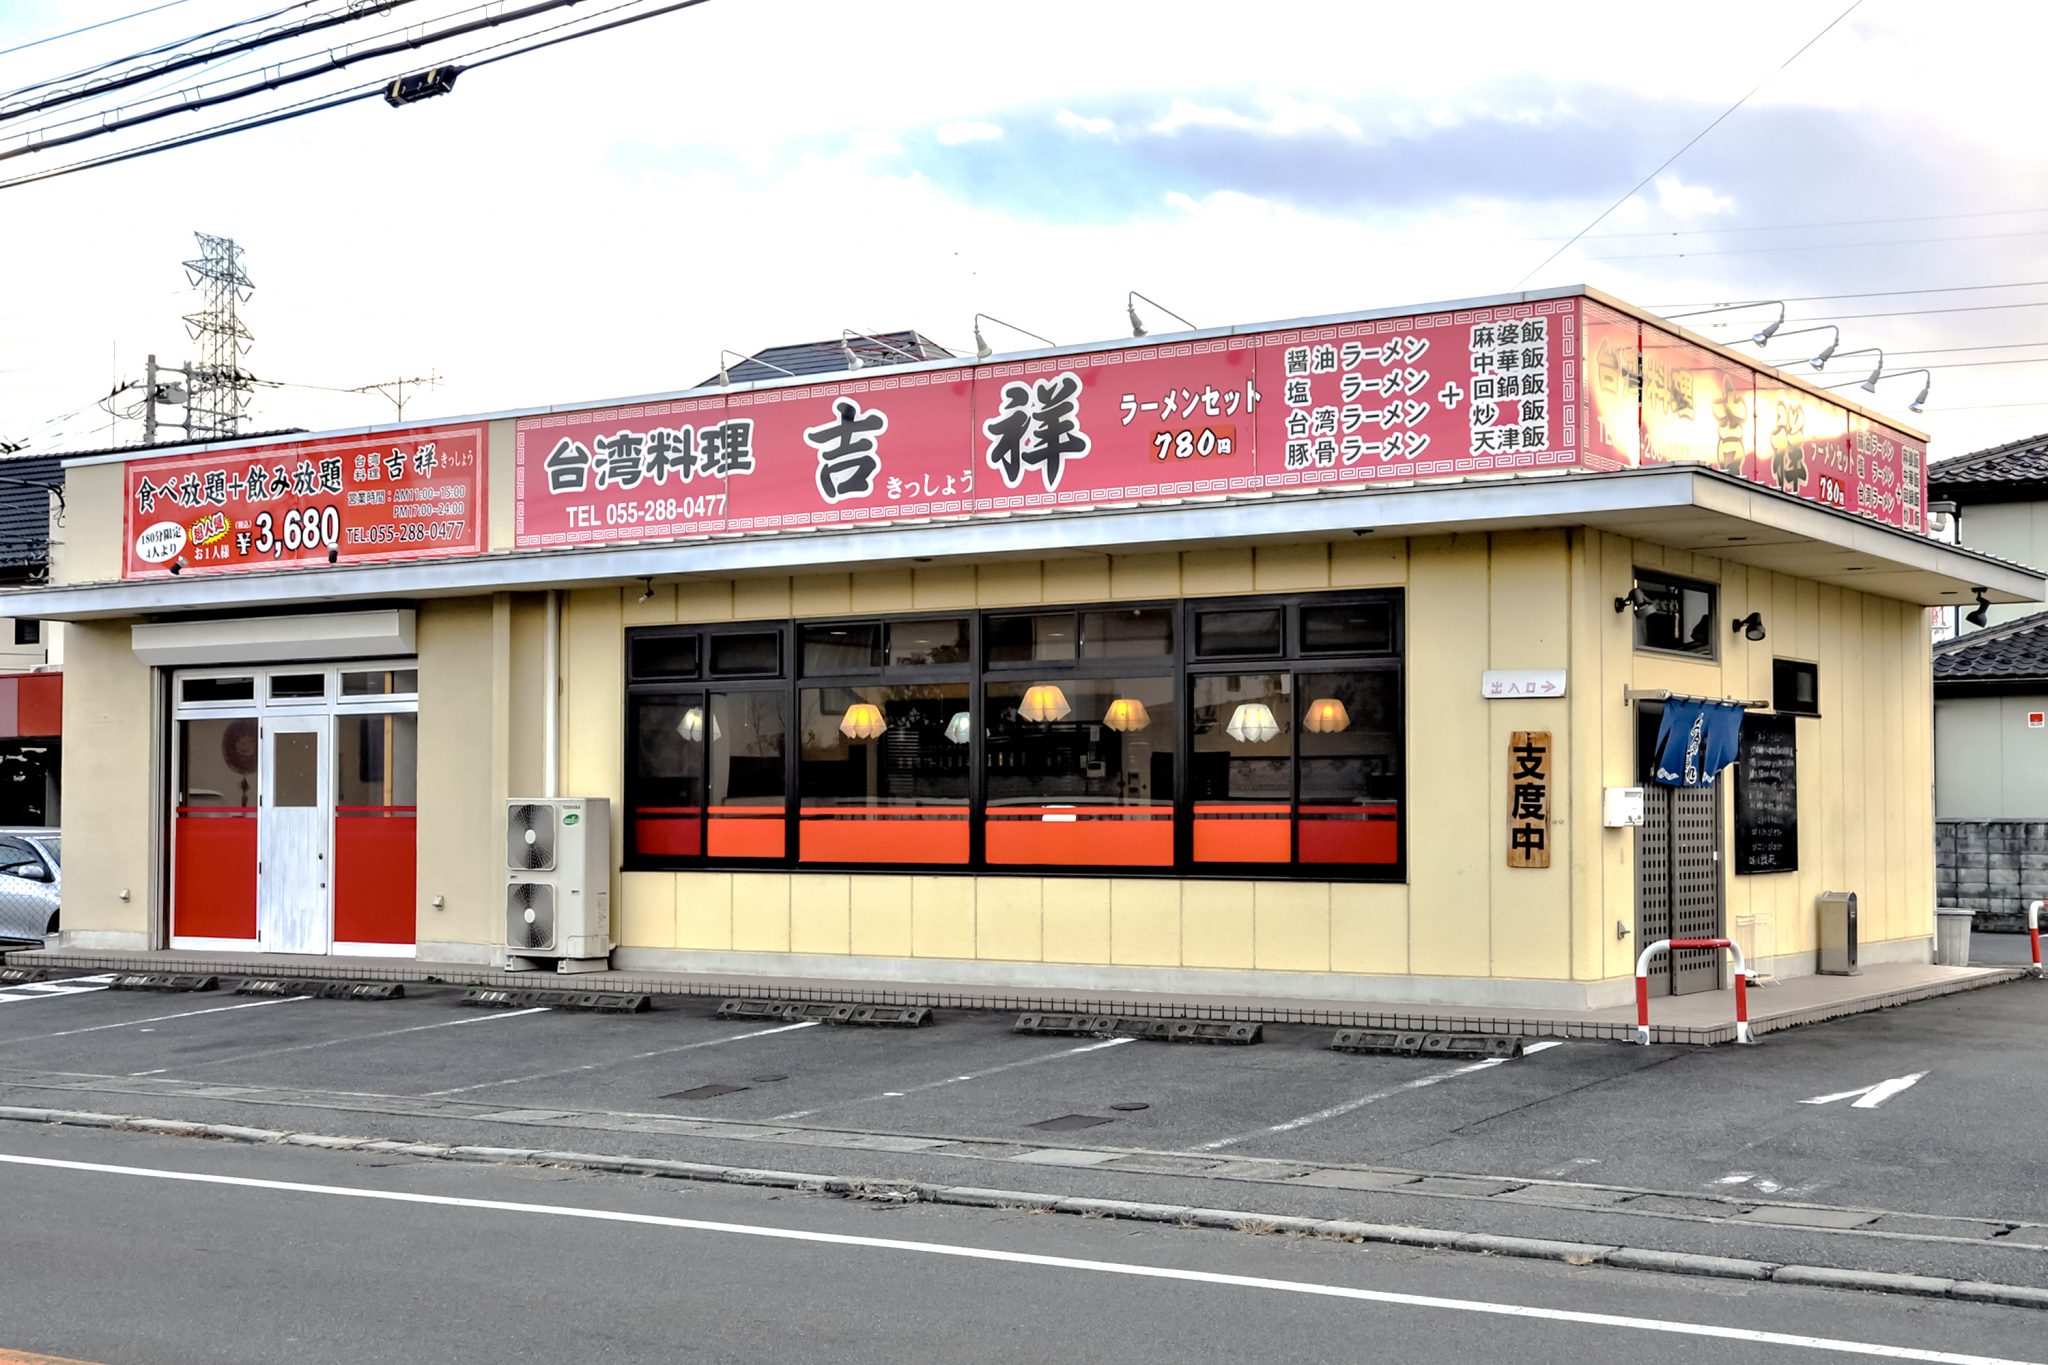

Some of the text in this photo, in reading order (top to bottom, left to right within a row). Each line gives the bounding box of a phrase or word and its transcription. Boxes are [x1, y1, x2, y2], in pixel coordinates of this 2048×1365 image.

[1471, 317, 1547, 350] 麻婆飯
[1286, 336, 1429, 376] 醤油ラーメン
[1471, 345, 1547, 375] 中華飯
[1120, 379, 1262, 426] ラーメンセット
[1471, 371, 1547, 402] 回鍋飯
[1286, 399, 1429, 438] 台湾ラーメン
[544, 418, 755, 494] 台湾料理
[1153, 428, 1232, 461] 780円
[1286, 431, 1429, 468] 豚骨ラーメン
[1471, 424, 1547, 455] 天津飯
[441, 450, 473, 469] きっしょう
[886, 470, 973, 499] きっしょう
[566, 494, 727, 528] TEL 055-288-0477
[1490, 681, 1537, 695] 出入口
[1512, 741, 1546, 861] 支度中
